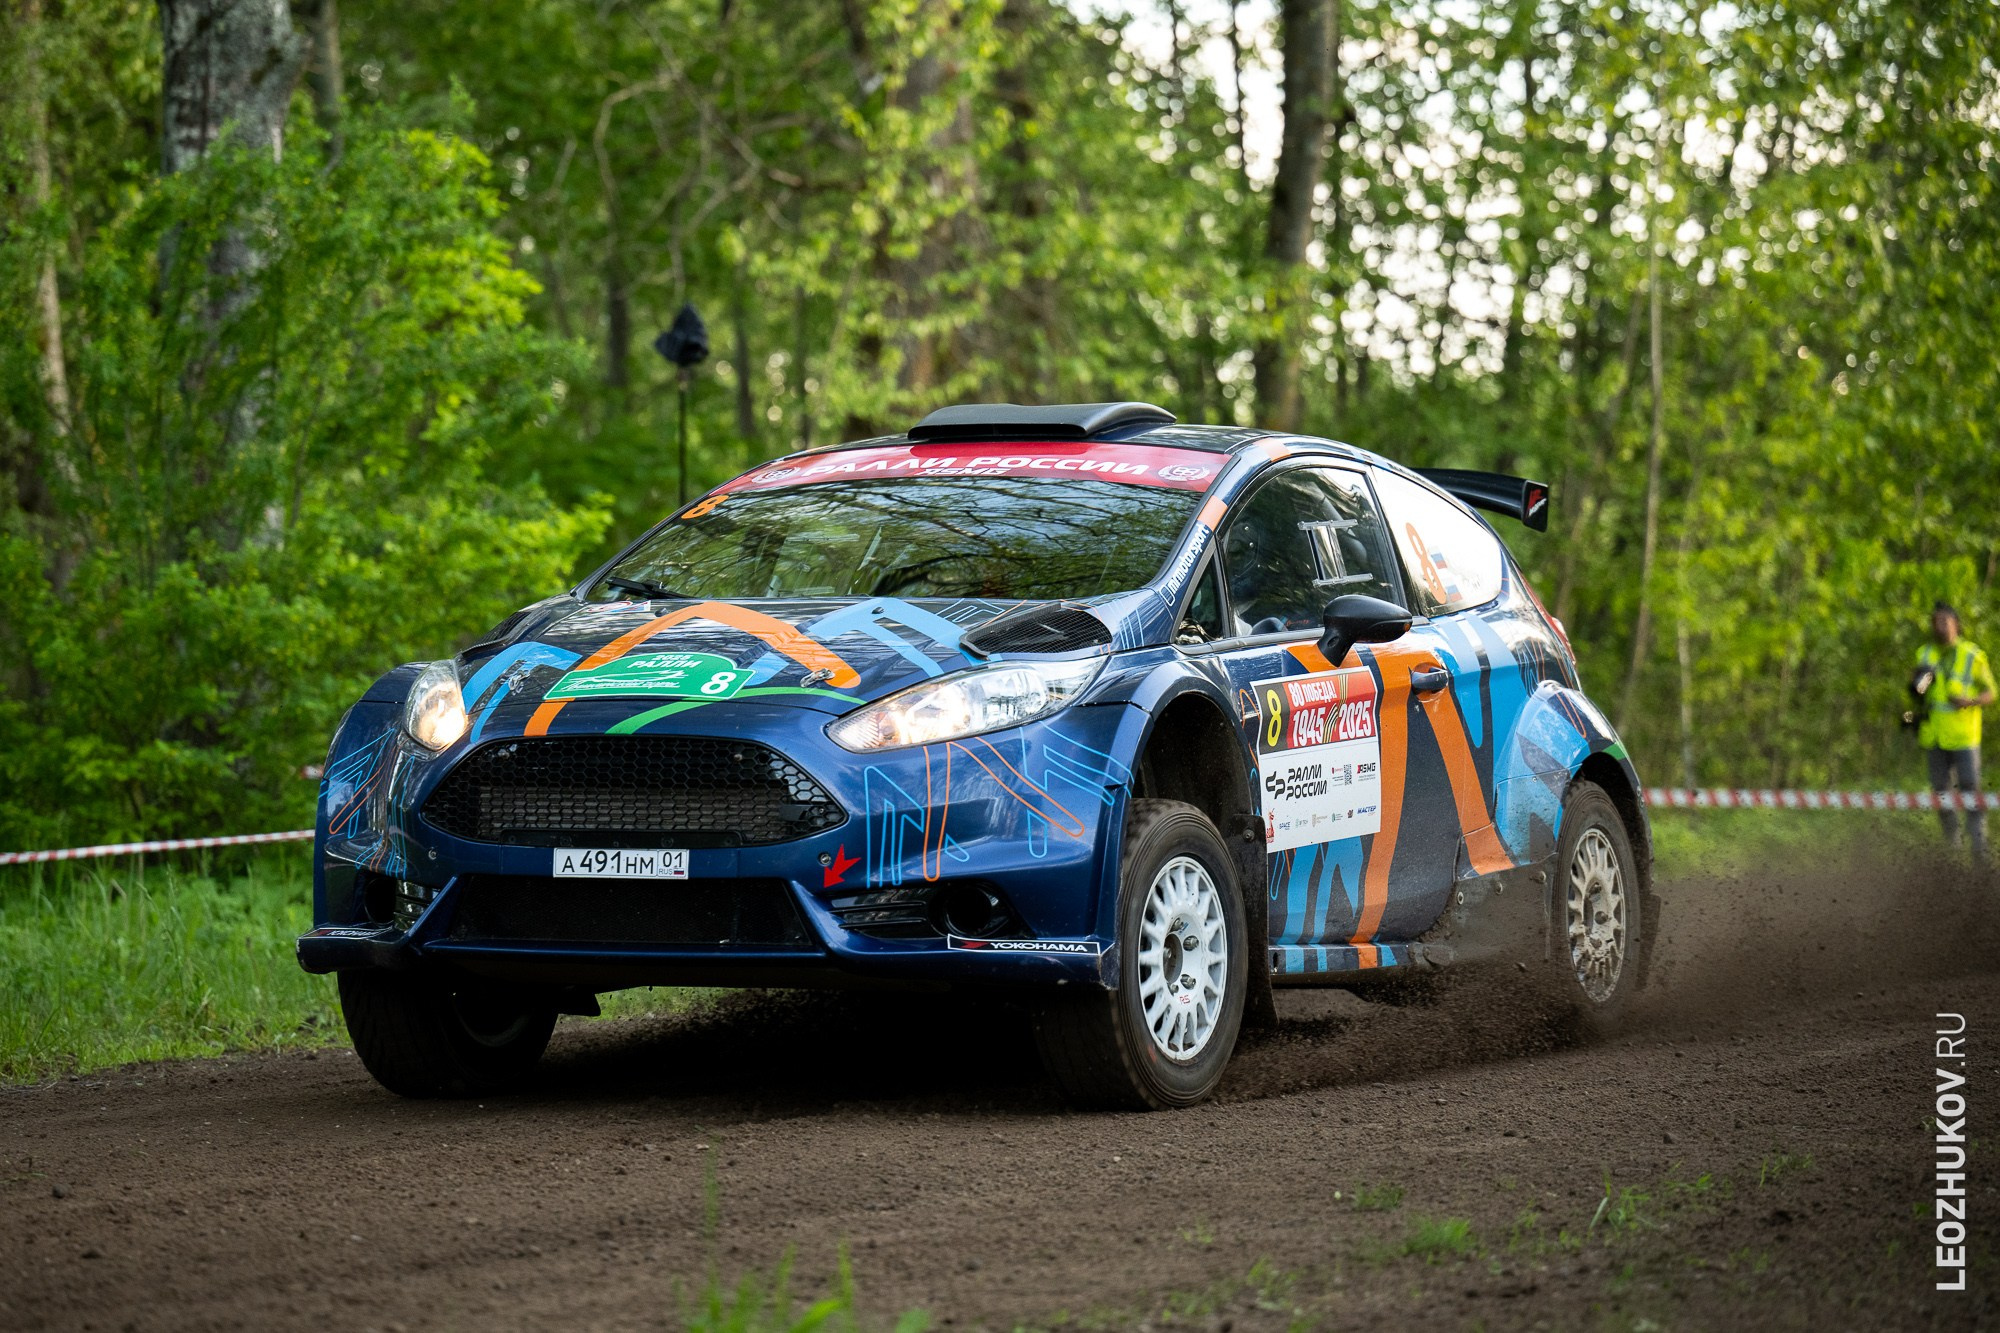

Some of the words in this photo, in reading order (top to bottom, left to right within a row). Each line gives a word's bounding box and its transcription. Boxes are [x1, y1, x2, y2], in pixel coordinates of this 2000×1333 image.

[801, 457, 958, 477] РАЛЛИ
[966, 456, 1150, 476] РОССИИ
[681, 495, 729, 518] 8
[1406, 522, 1447, 605] 8
[627, 660, 702, 669] РАЛЛИ
[700, 672, 737, 694] 8
[1288, 682, 1305, 708] 80
[1301, 680, 1338, 703] ПОБЕДА!
[1266, 689, 1282, 747] 8
[1293, 707, 1326, 748] 1945
[1338, 700, 1372, 740] 2025
[1287, 763, 1322, 783] РАЛЛИ
[1286, 780, 1328, 800] РОССИИ
[663, 851, 683, 868] 01
[990, 942, 1088, 952] YOKOHAMA
